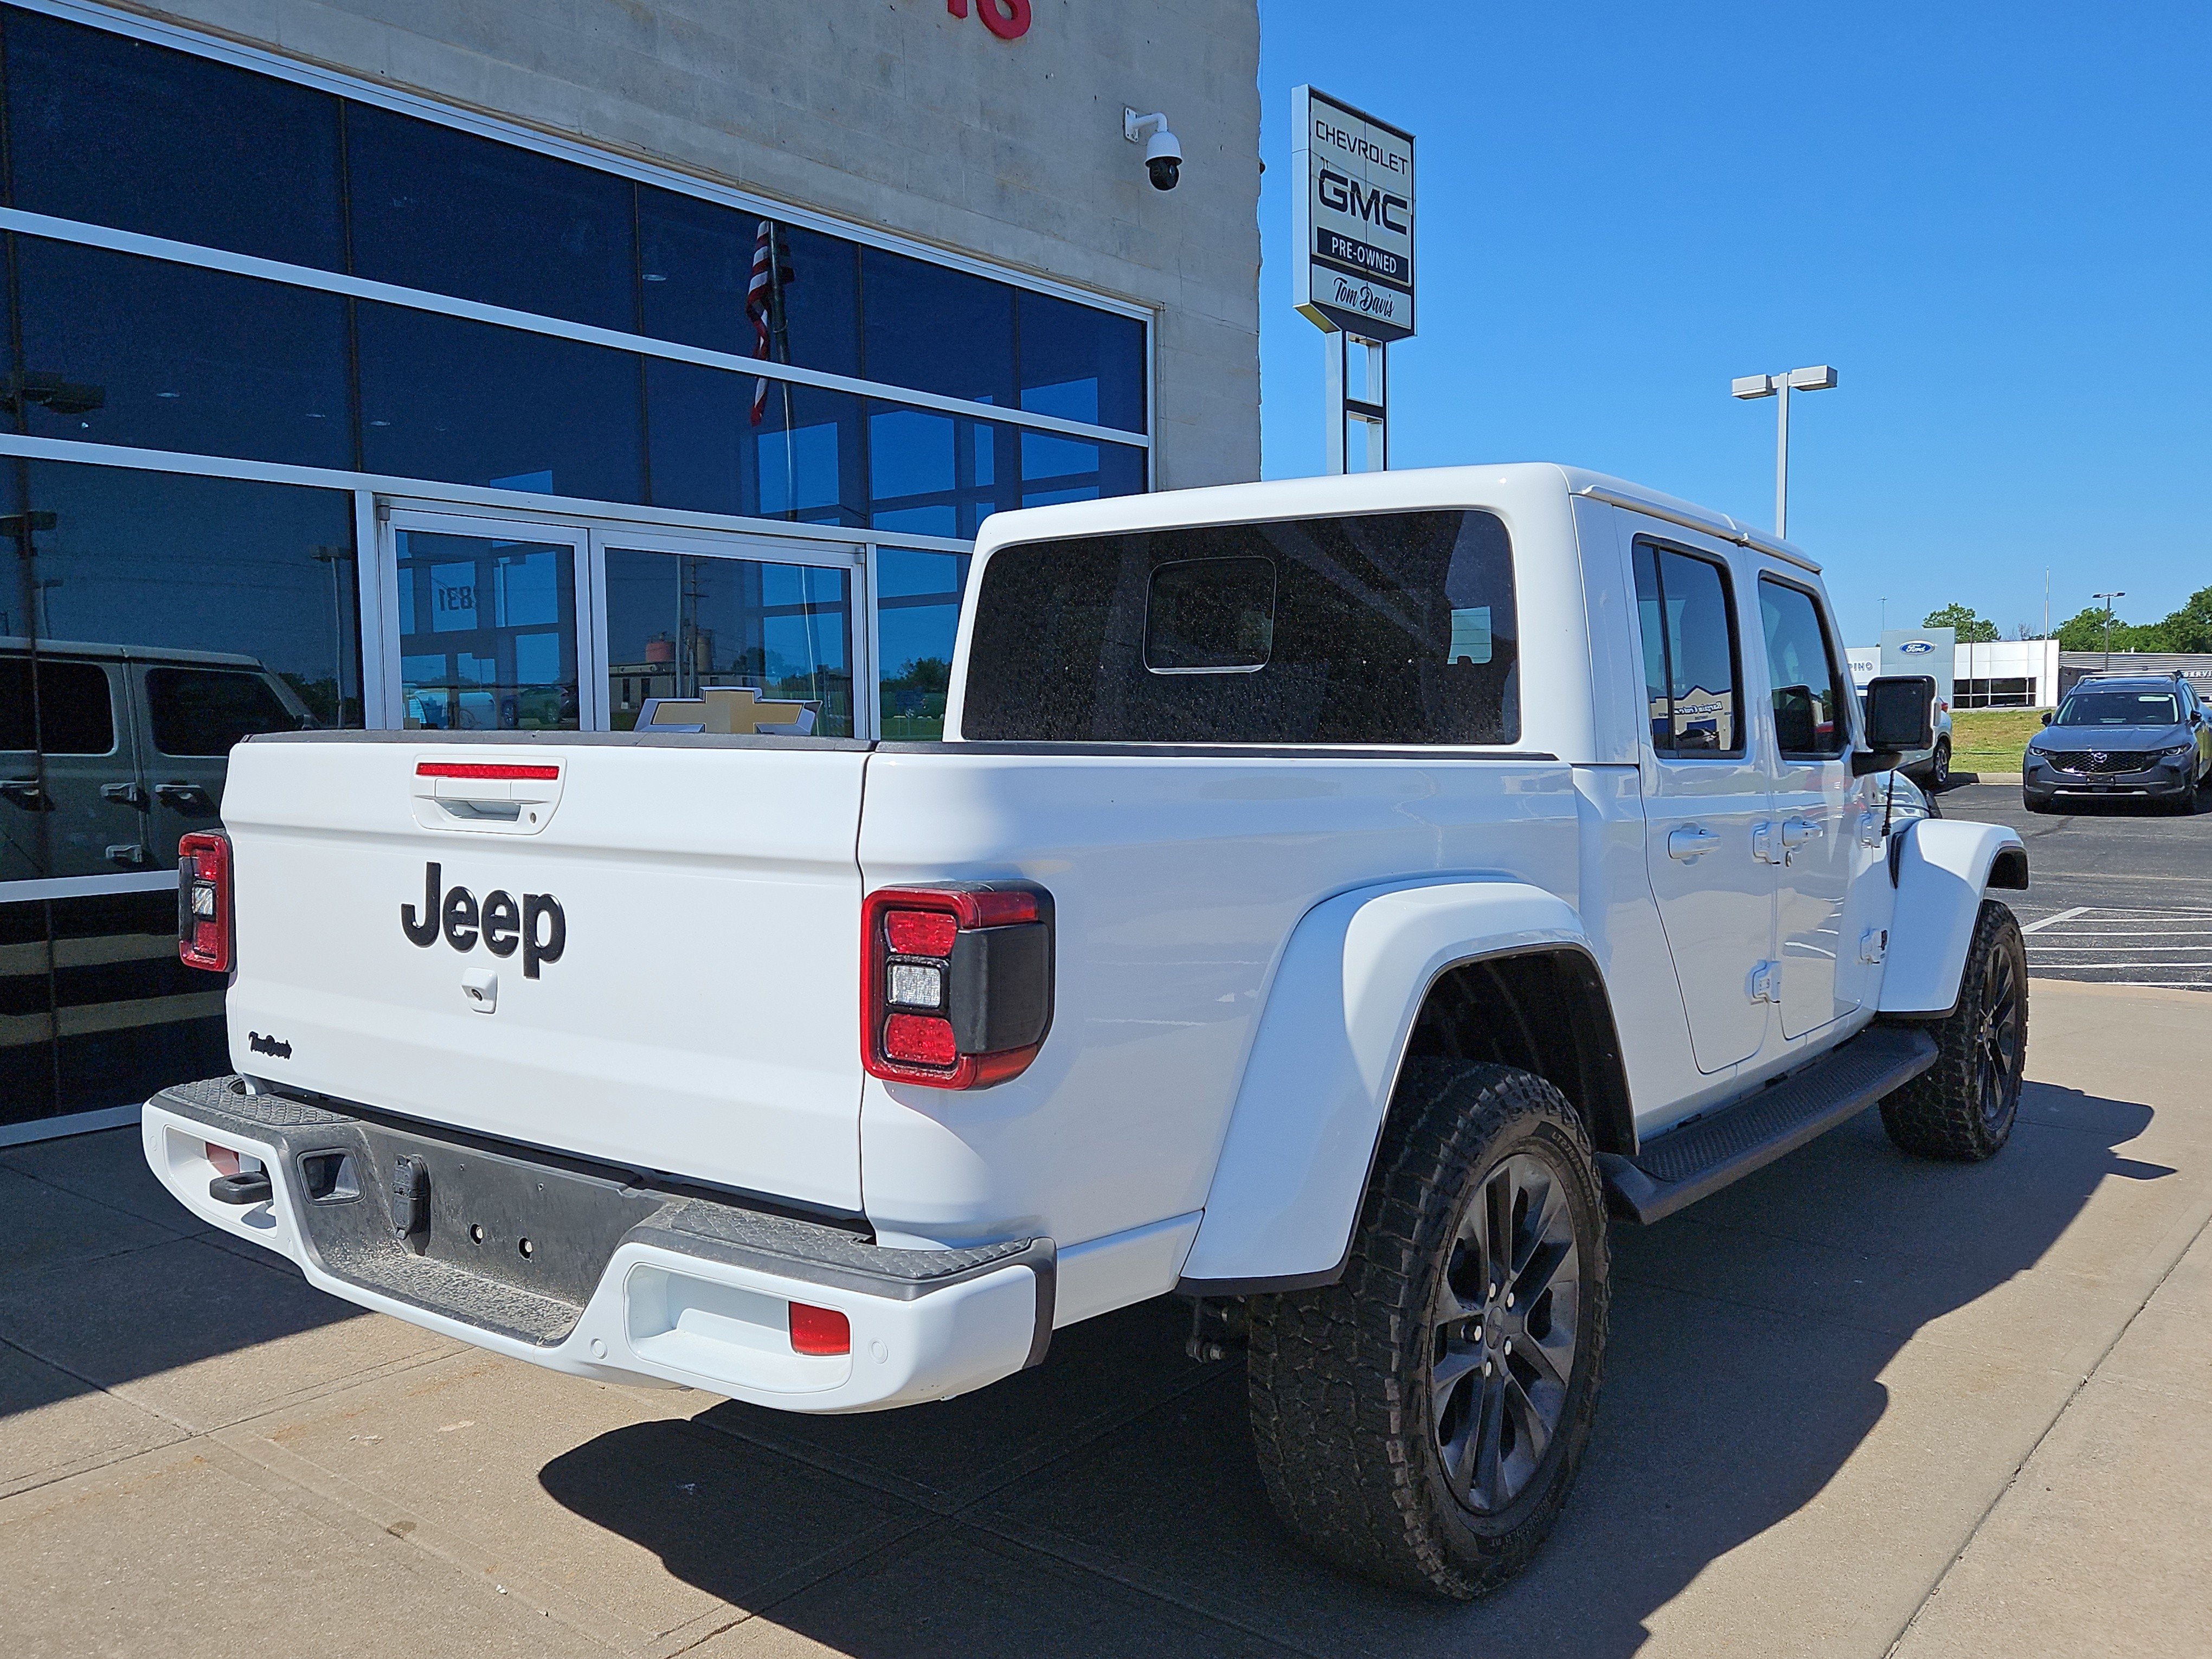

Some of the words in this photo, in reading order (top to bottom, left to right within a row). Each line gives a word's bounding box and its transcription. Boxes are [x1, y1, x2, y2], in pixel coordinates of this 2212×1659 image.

[1316, 120, 1408, 175] CHEVROLET
[1319, 169, 1407, 235] GMC
[1332, 236, 1397, 273] PRE-OWNED
[1333, 277, 1359, 308] Tom
[1360, 286, 1394, 318] Davis
[401, 861, 565, 980] Jeep
